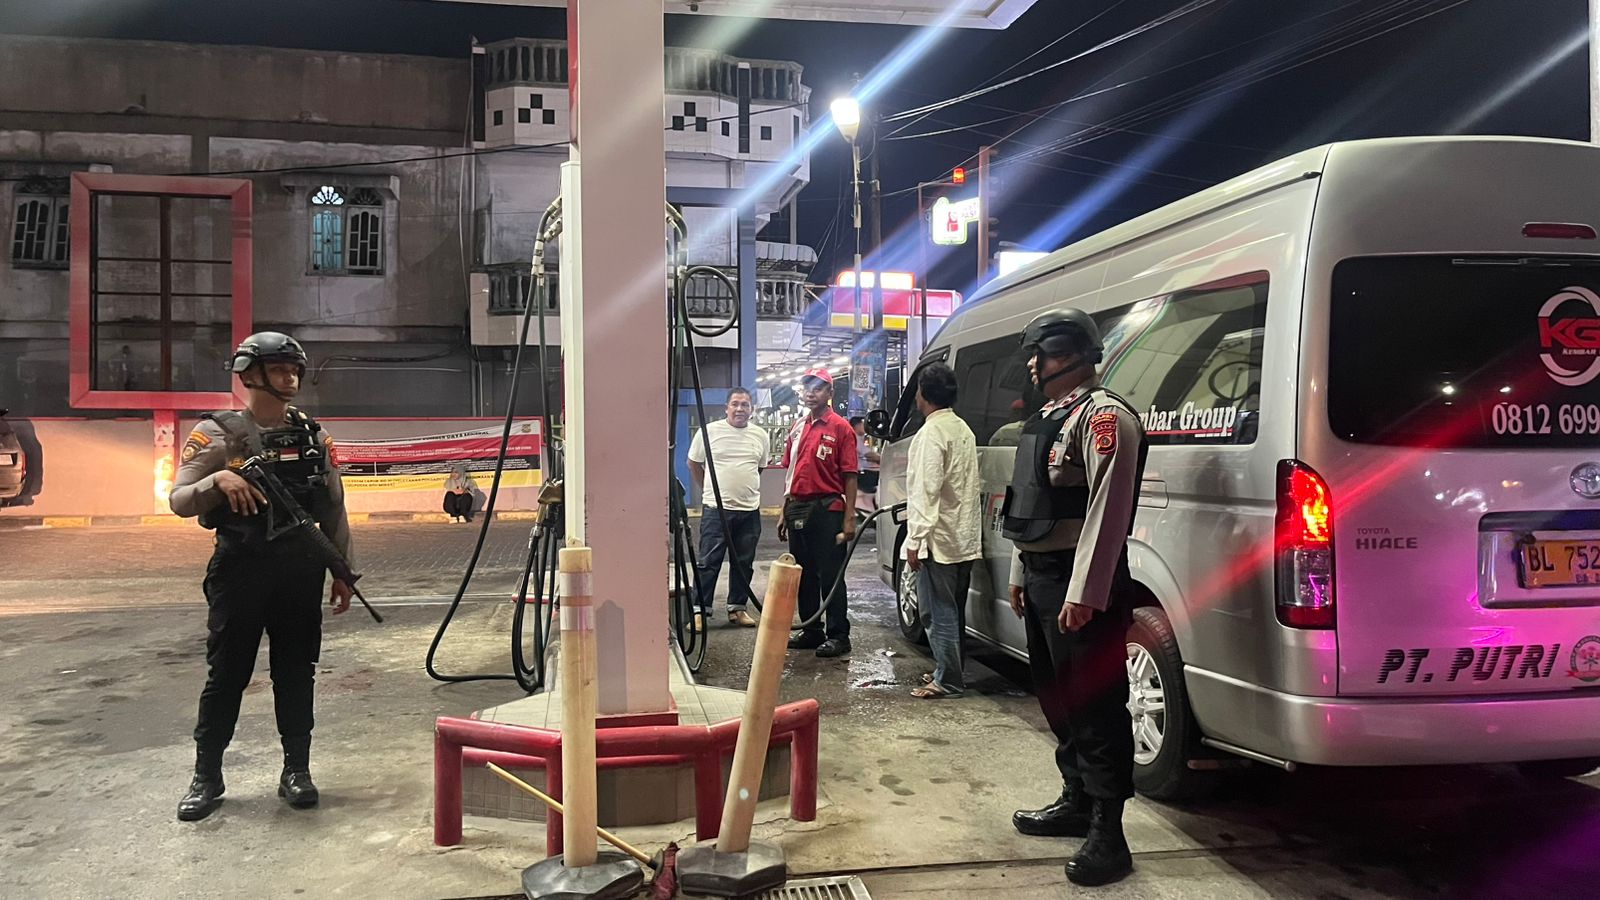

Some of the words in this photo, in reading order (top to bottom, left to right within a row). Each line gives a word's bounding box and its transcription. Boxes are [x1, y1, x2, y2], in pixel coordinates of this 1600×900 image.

[1180, 401, 1237, 436] Group
[1492, 403, 1552, 435] 0812
[1355, 537, 1418, 550] HIACE
[1357, 527, 1390, 535] TOYOTA
[1528, 546, 1555, 572] BL
[1564, 545, 1600, 570] 752
[1376, 648, 1435, 684] PT.
[1446, 643, 1561, 682] PUTRI
